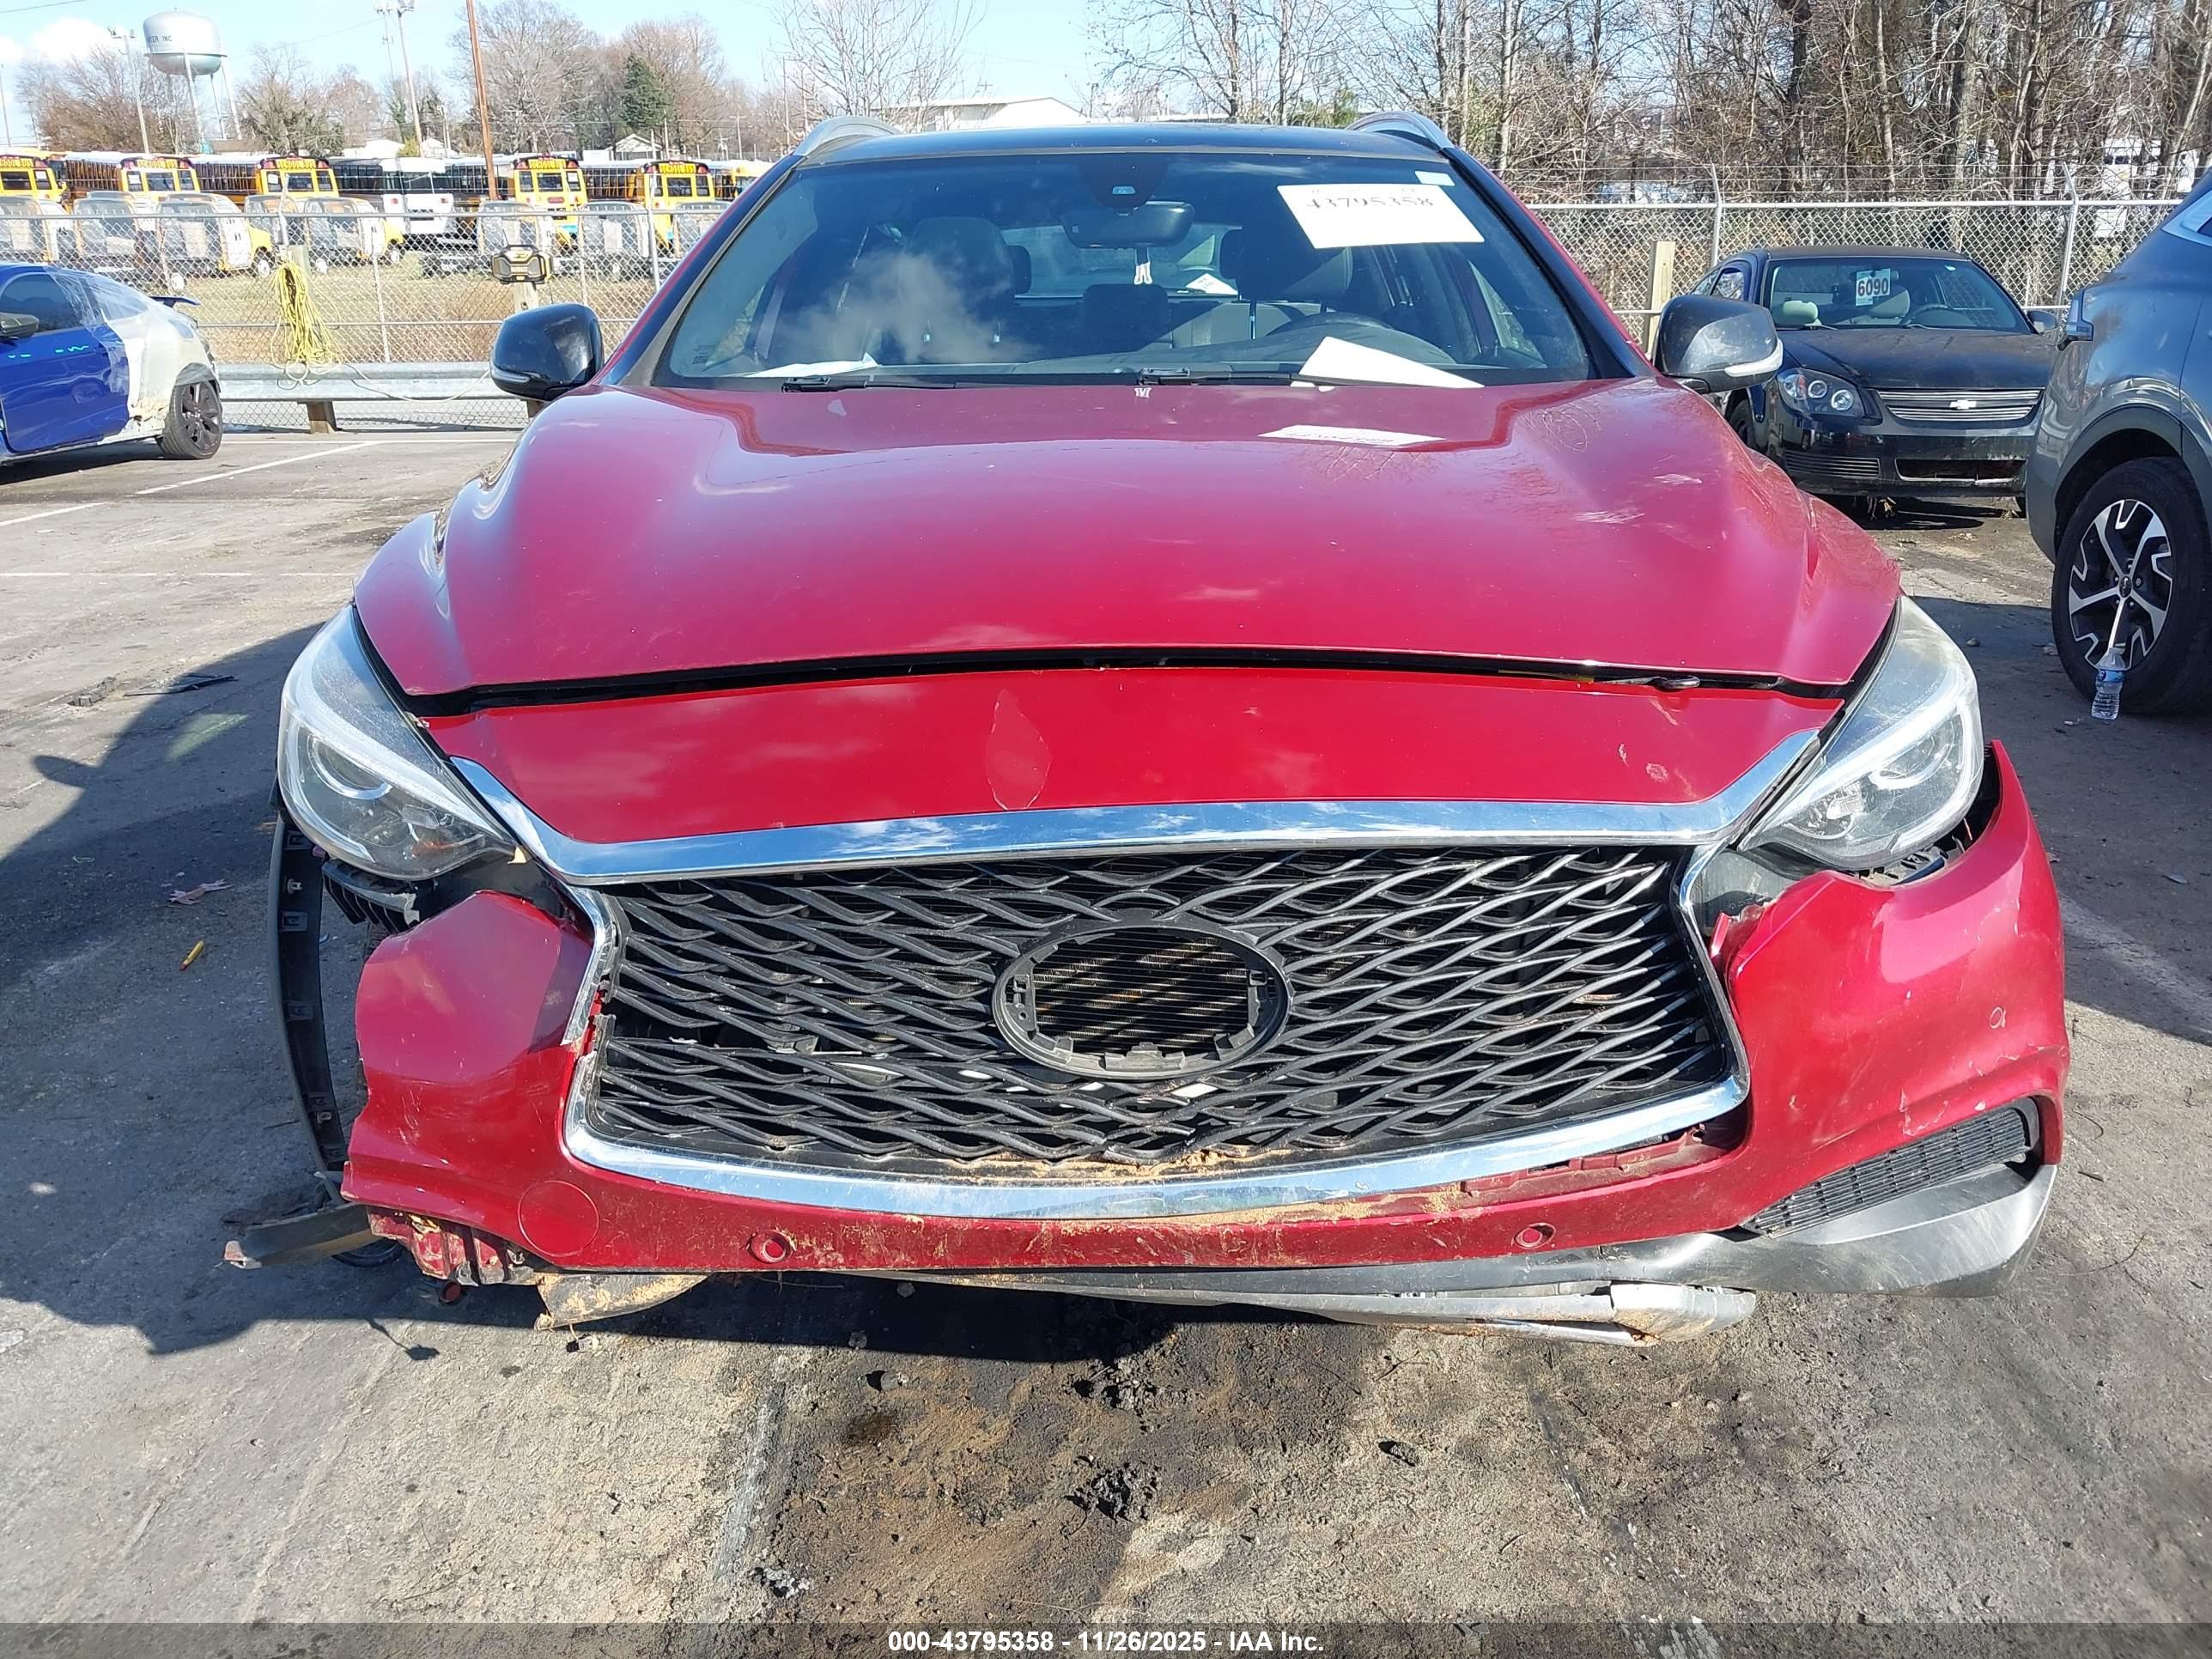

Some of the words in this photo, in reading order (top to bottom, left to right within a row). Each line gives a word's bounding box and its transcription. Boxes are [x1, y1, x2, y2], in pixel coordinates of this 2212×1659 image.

[137, 160, 164, 169] SCHOOL
[164, 160, 176, 169] BUS
[1857, 277, 1889, 297] 6090
